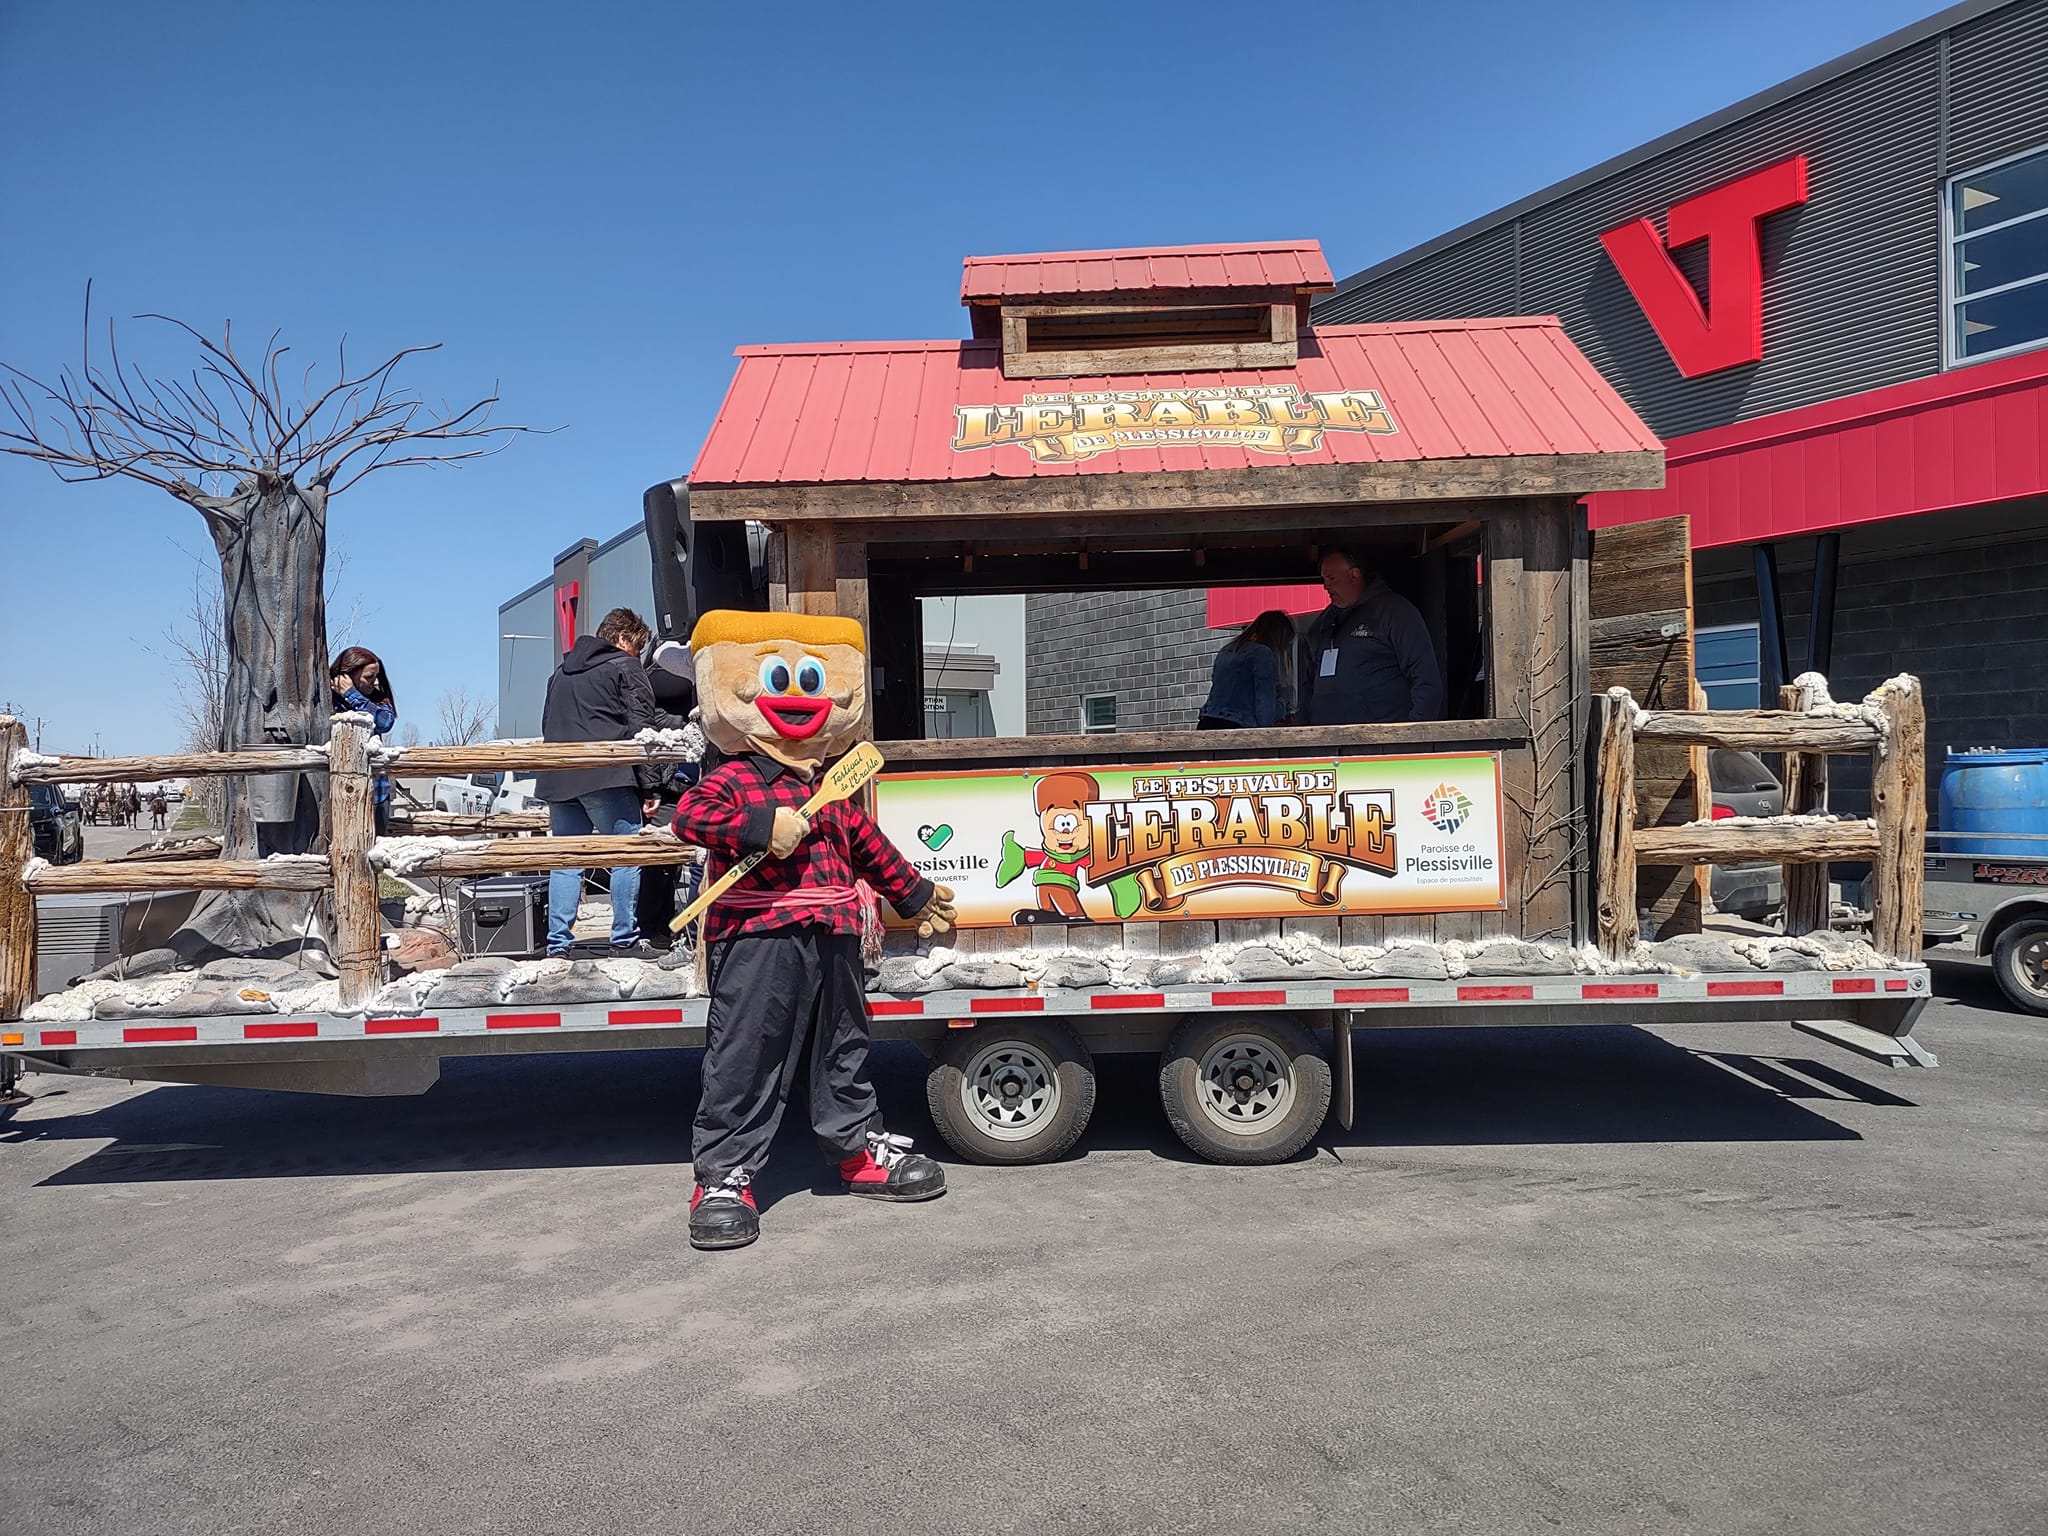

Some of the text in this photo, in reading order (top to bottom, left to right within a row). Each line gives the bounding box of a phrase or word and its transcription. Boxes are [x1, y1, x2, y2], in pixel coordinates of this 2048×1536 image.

[830, 751, 864, 786] Festival
[840, 782, 849, 792] de
[1135, 772, 1334, 796] LE FESTIVAL DE
[1421, 843, 1476, 853] Paroisse de
[912, 854, 989, 871] ssisville
[1171, 855, 1311, 886] DE PLESSISVILLE
[1405, 855, 1493, 872] Plessisville
